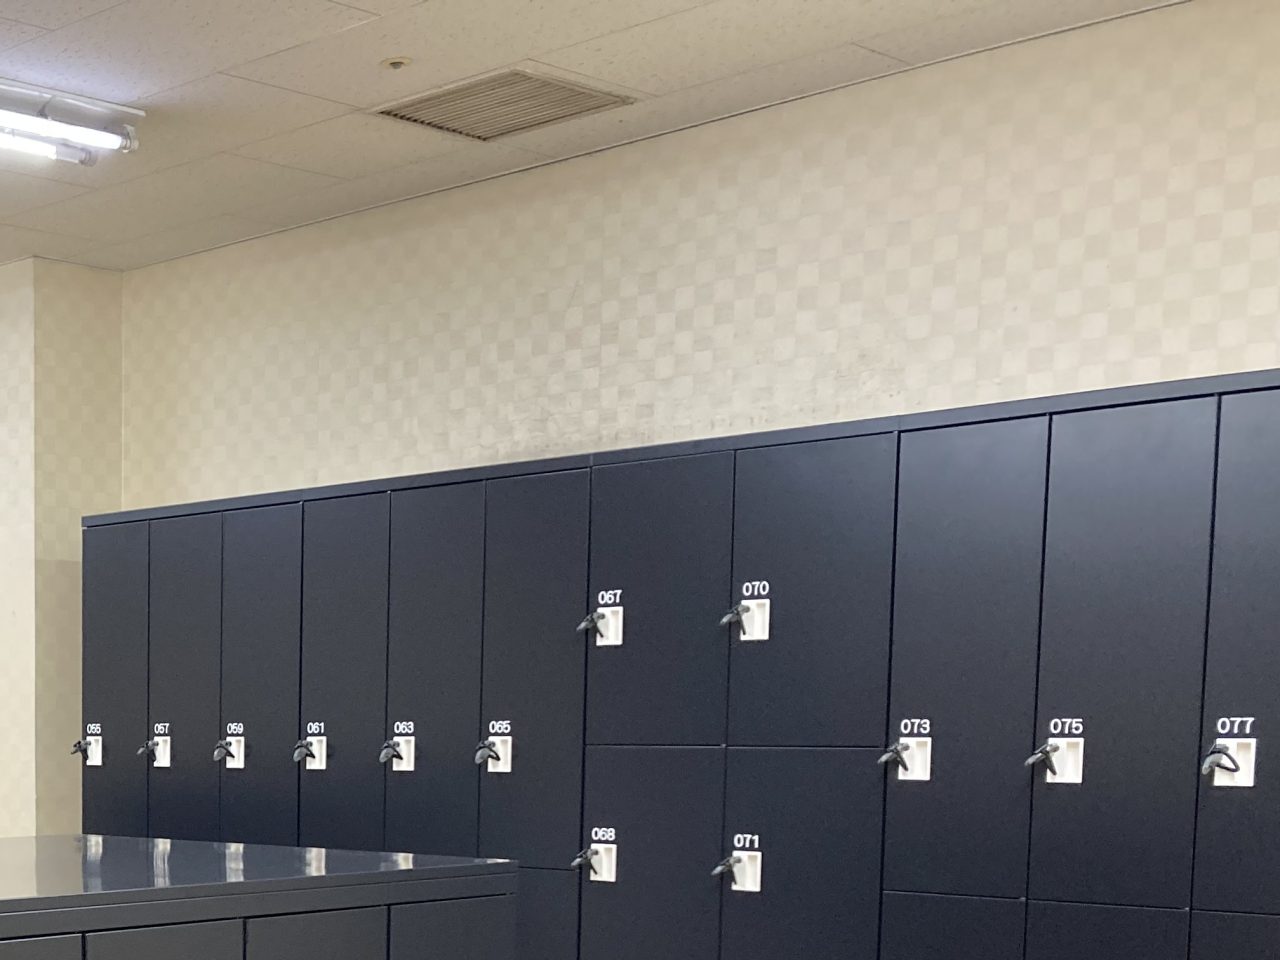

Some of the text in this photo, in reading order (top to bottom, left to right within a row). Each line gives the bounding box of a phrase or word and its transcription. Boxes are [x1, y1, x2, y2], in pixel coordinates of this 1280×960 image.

[743, 581, 769, 596] 070
[598, 590, 622, 604] 067
[87, 724, 101, 734] 055
[154, 723, 169, 734] 057
[227, 723, 243, 734] 059
[307, 722, 324, 733] 061
[394, 722, 414, 733] 063
[489, 721, 511, 733] 065
[901, 719, 930, 734] 073
[1050, 718, 1083, 734] 075
[1217, 717, 1254, 734] 077
[592, 828, 615, 841] 068
[734, 834, 758, 848] 071
